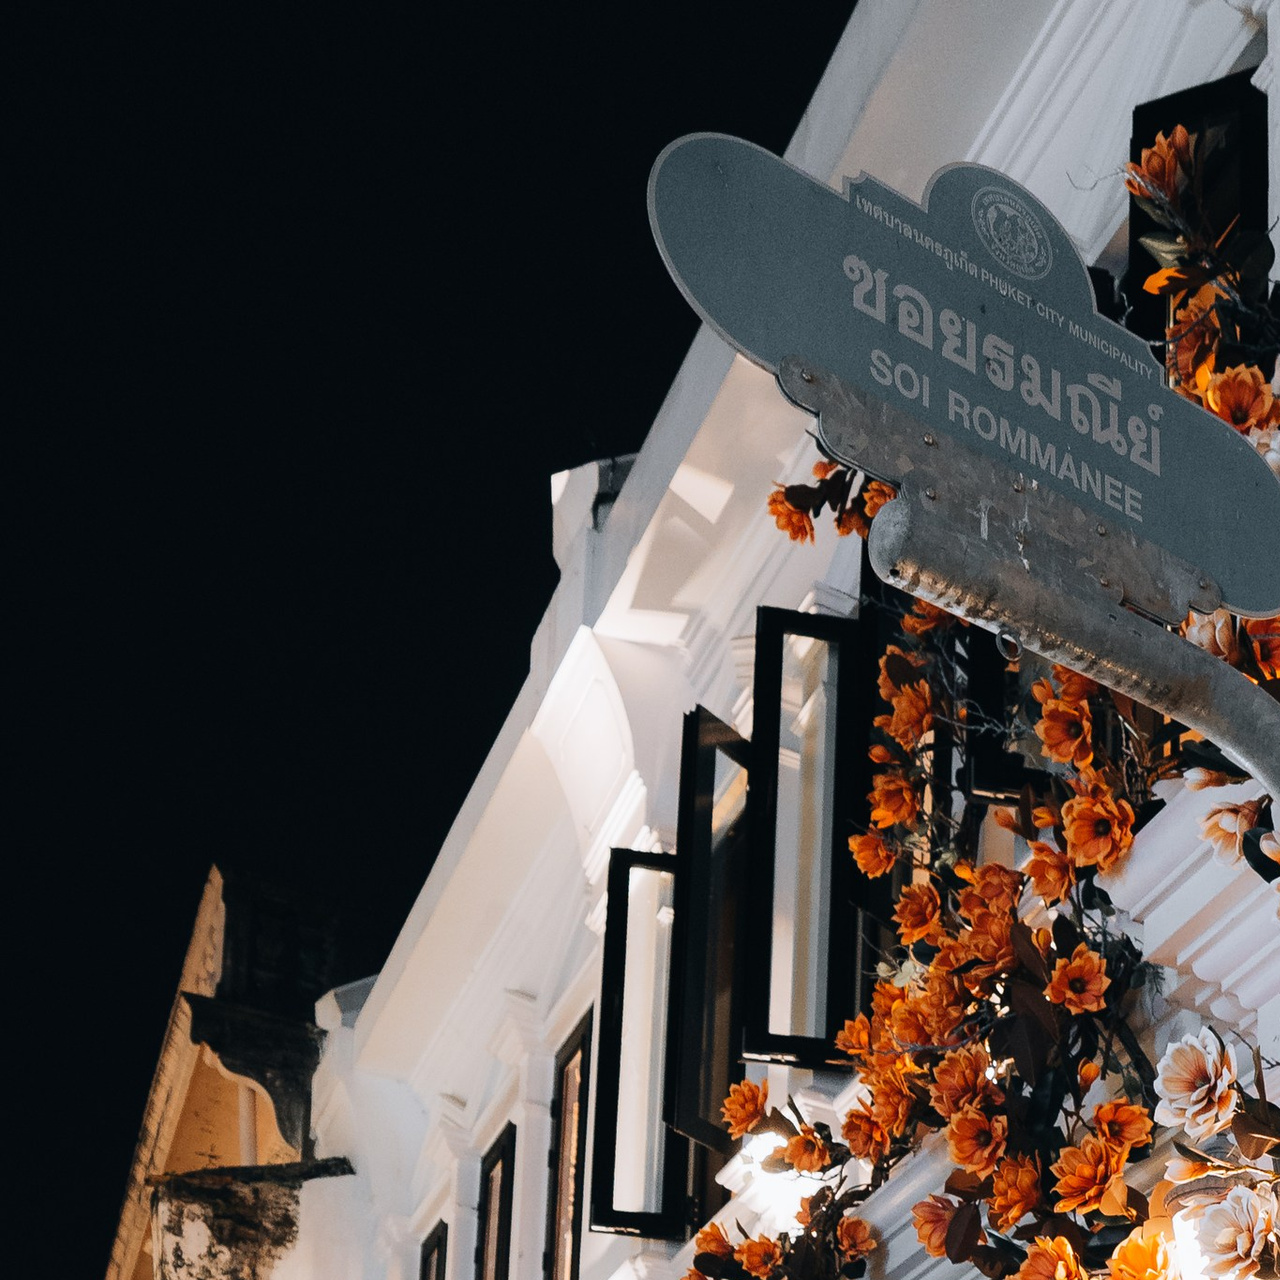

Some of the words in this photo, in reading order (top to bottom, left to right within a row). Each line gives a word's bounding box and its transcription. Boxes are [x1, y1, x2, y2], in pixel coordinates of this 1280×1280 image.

[843, 254, 1164, 478] ซอยรมณีย์
[981, 267, 1032, 309] PHUKET
[1036, 302, 1065, 328] CITY
[1068, 320, 1153, 380] MUNICIPALITY
[869, 349, 930, 409] SOI
[948, 388, 1144, 523] ROMMANEE
